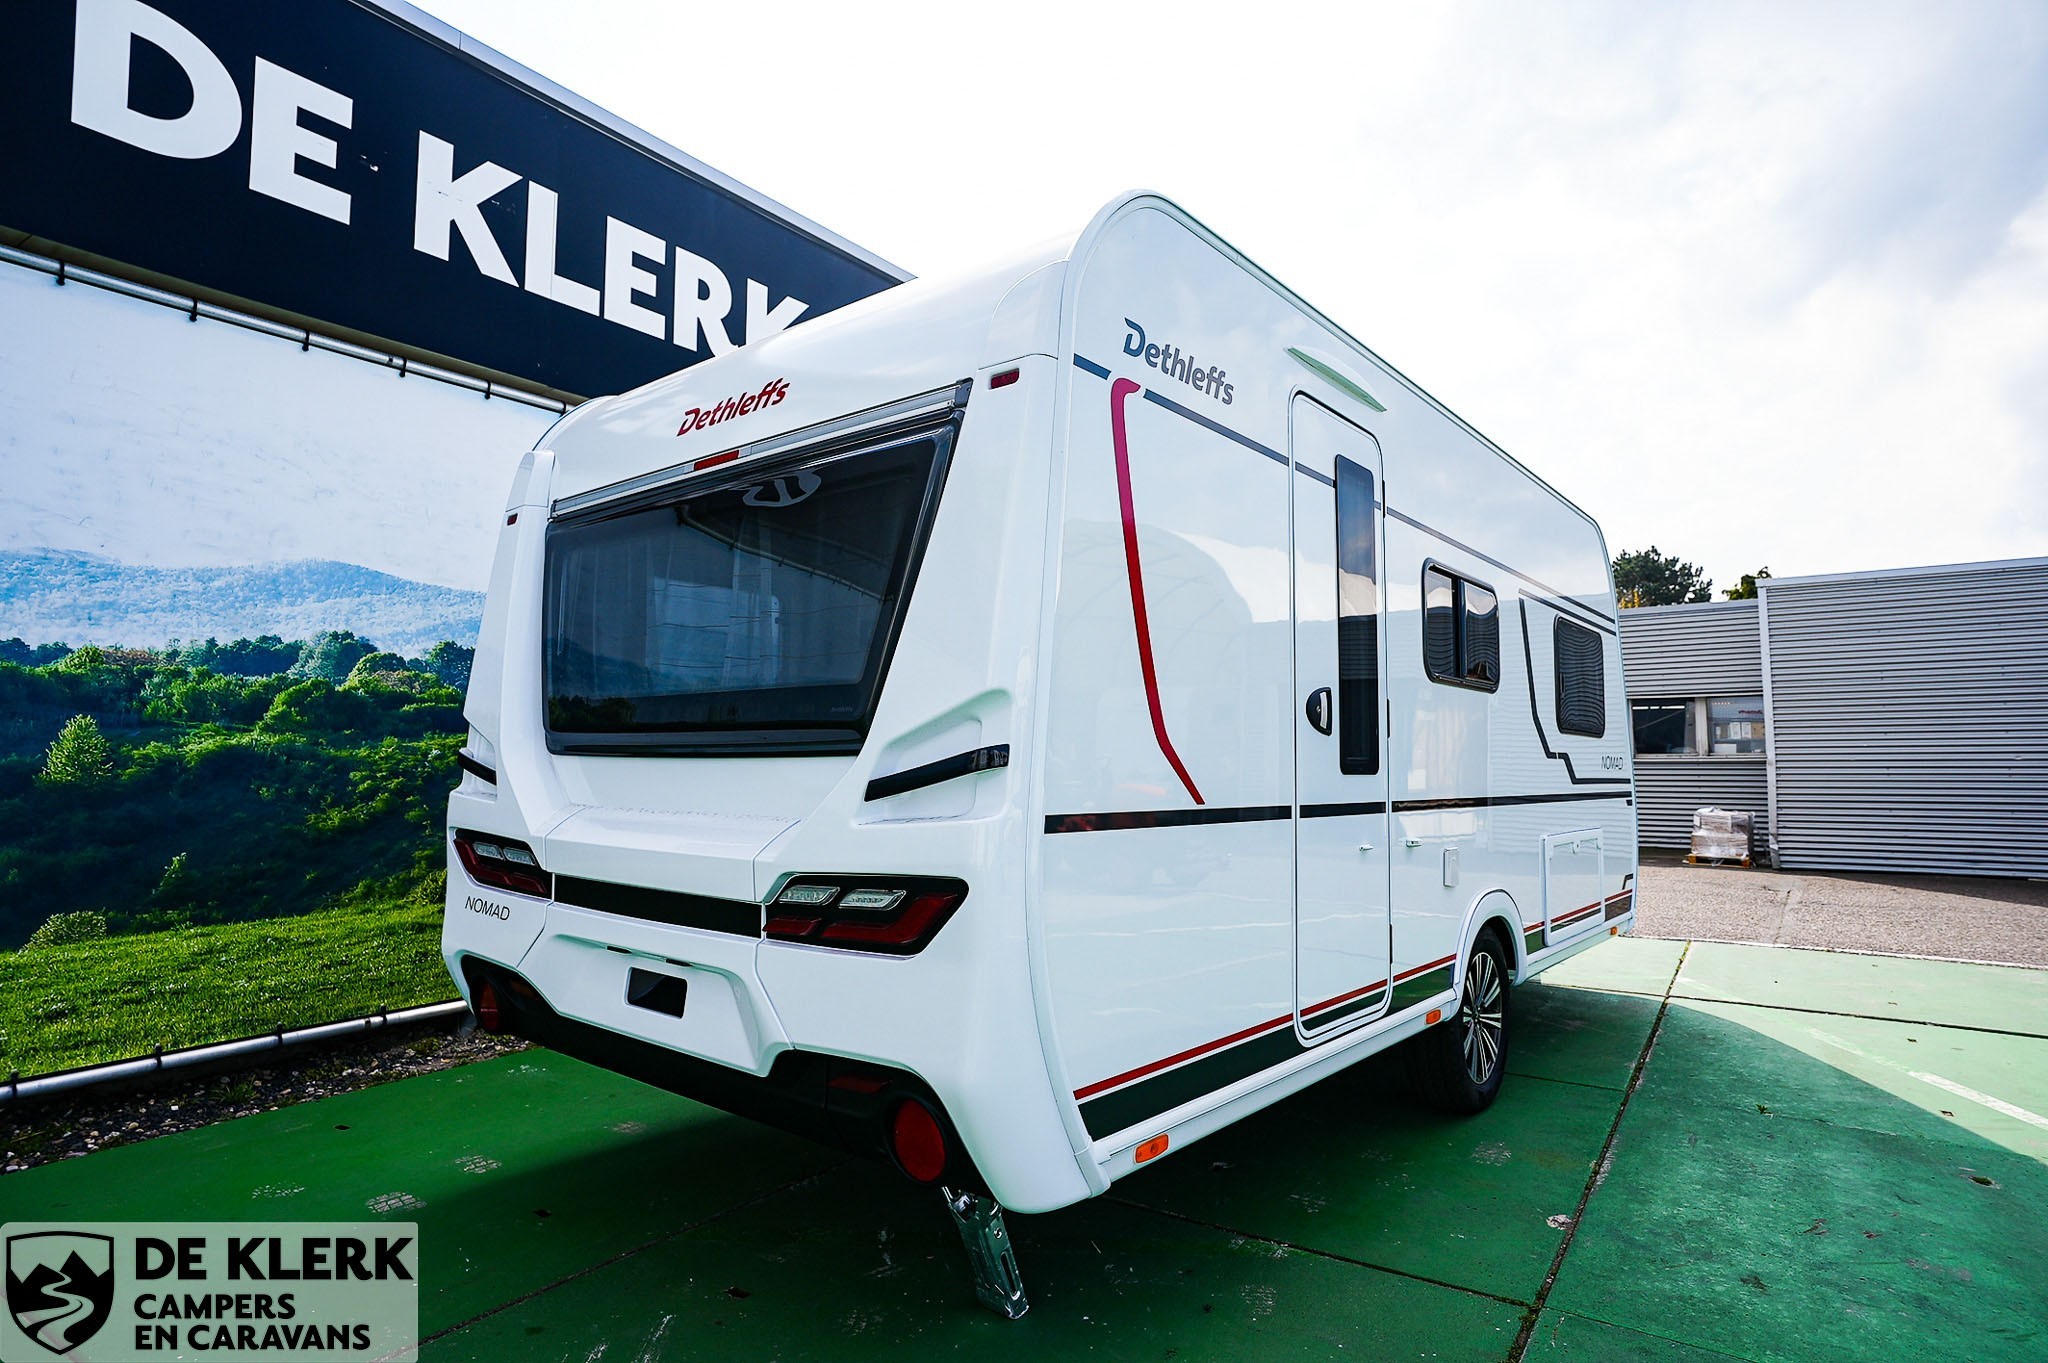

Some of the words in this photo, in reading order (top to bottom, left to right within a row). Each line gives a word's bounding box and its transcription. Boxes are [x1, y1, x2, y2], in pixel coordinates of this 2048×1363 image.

[70, 0, 354, 226] DE
[1123, 317, 1235, 406] Dethleffs
[677, 377, 791, 436] Dethleffs
[1601, 755, 1624, 770] NOMAD
[464, 895, 511, 921] NOMAD
